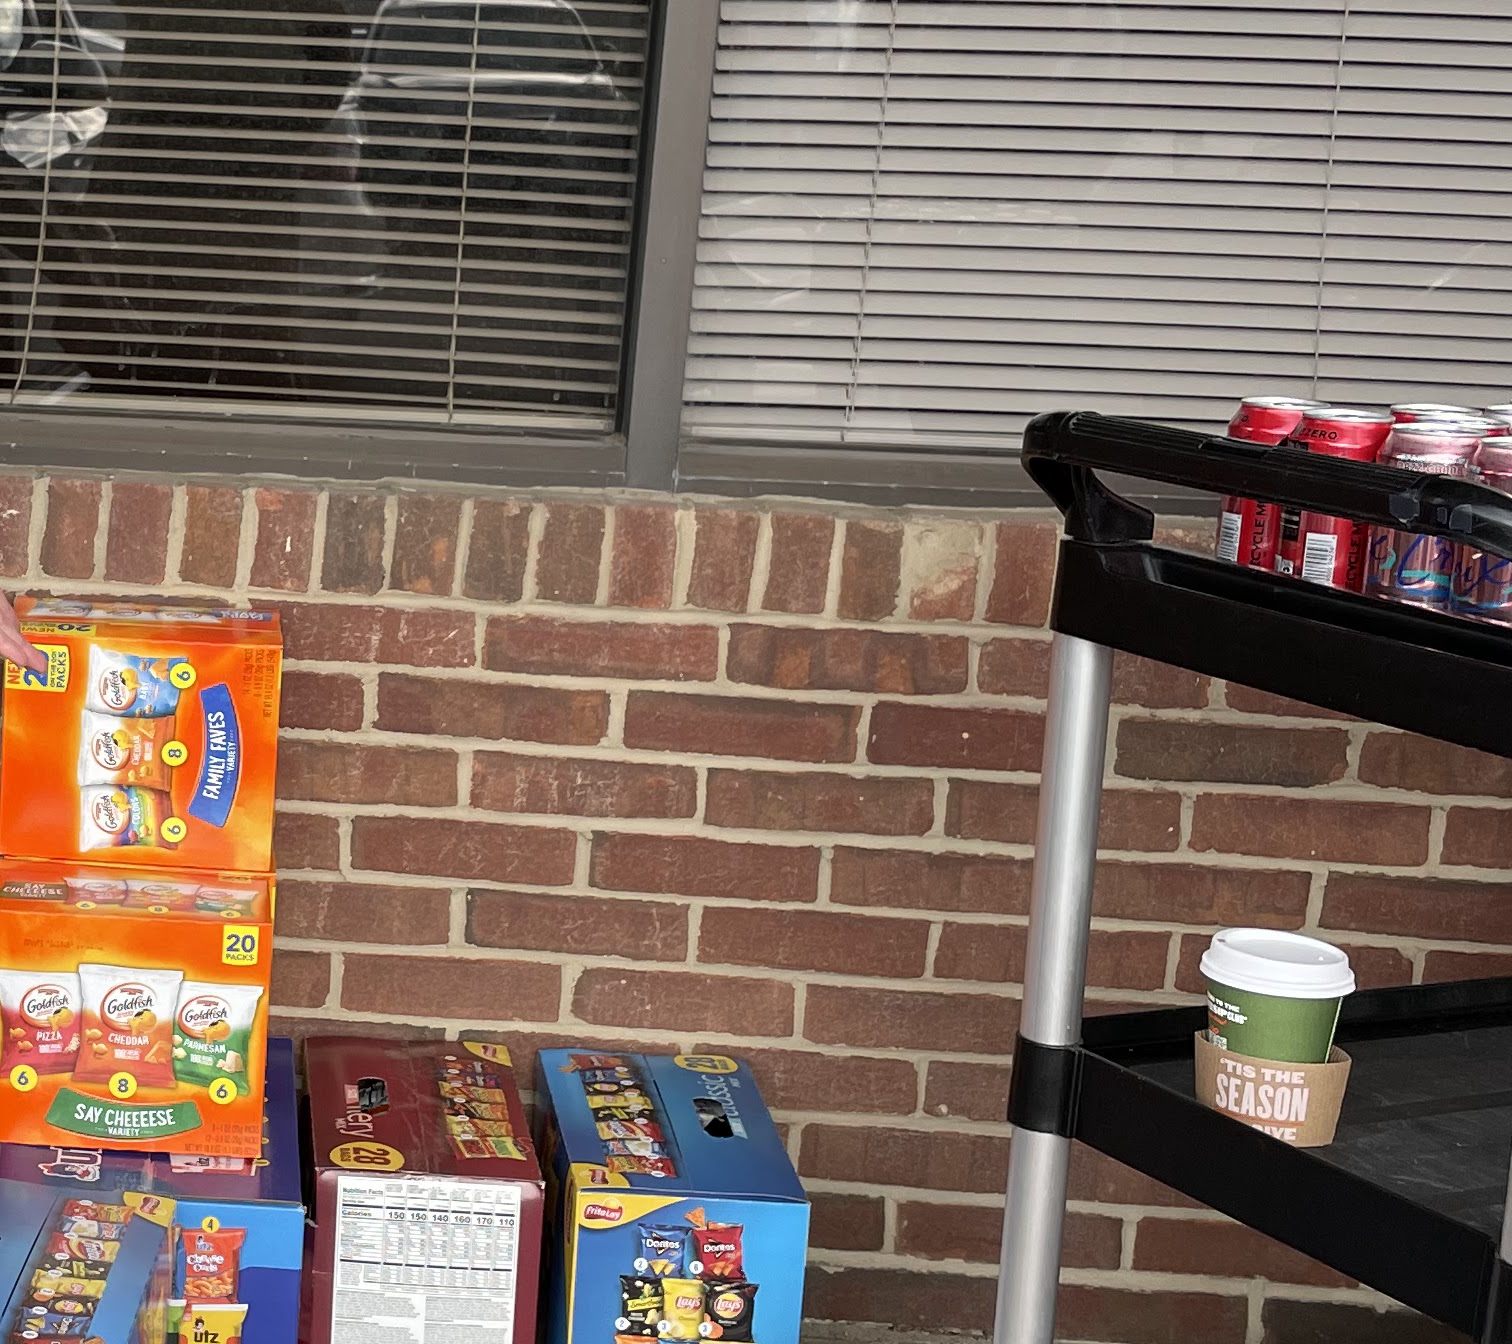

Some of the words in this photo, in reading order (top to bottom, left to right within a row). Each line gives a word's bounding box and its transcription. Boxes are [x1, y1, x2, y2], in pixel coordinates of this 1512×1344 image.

[23, 649, 50, 687] 2
[56, 651, 66, 689] PACKS
[207, 711, 226, 751] FAVES
[226, 741, 236, 773] VARIETY
[202, 755, 226, 800] FAMILY
[226, 933, 256, 953] 20
[225, 953, 255, 961] PACKS
[27, 994, 50, 1014] Goldfish
[107, 994, 154, 1015] Goldfish
[184, 1006, 229, 1023] Goldfish
[36, 1030, 62, 1042] PIZZA
[107, 1033, 150, 1046] CHEDDAR
[182, 1038, 227, 1055] PARMESAN
[17, 1071, 29, 1086] 6
[1261, 1068, 1305, 1084] THE
[117, 1078, 129, 1093] 8
[216, 1084, 228, 1099] 6
[1215, 1073, 1309, 1122] SEASON
[54, 1103, 103, 1122] SAY
[104, 1109, 176, 1128] CHEEEESE
[108, 1126, 140, 1137] VARIETY
[352, 1146, 391, 1166] 28
[433, 1214, 449, 1222] 140
[645, 1238, 680, 1249] Doritos
[703, 1243, 736, 1253] Doritos
[193, 1330, 220, 1344] utz
